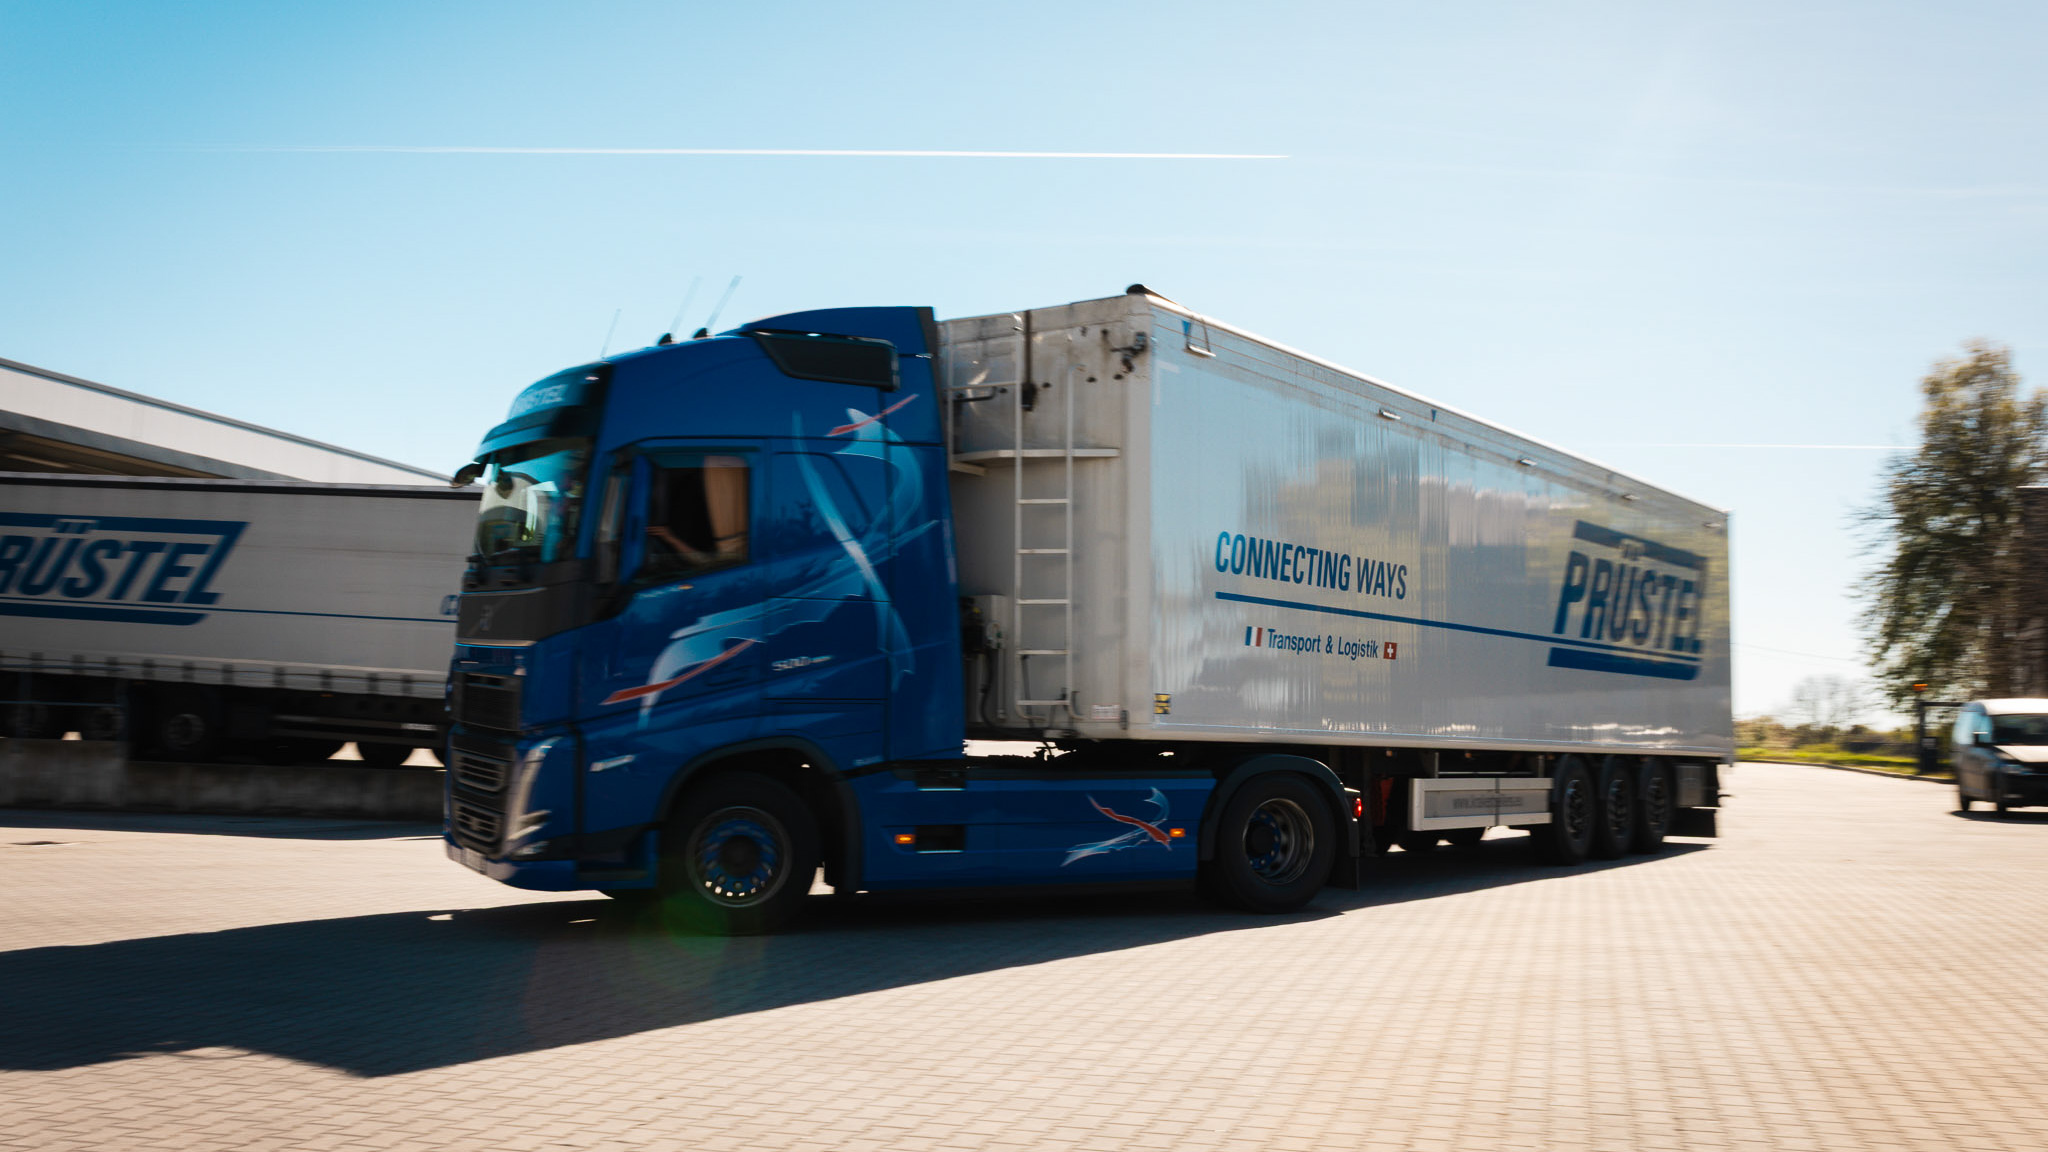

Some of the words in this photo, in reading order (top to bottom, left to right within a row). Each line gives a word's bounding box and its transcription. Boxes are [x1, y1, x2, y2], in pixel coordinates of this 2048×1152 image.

[1215, 531, 1351, 592] CONNECTING
[1356, 557, 1408, 600] WAYS
[1552, 541, 1706, 654] PRÜSTEL
[1267, 628, 1321, 656] Transport
[1325, 635, 1334, 654] &
[1337, 637, 1379, 661] Logistik
